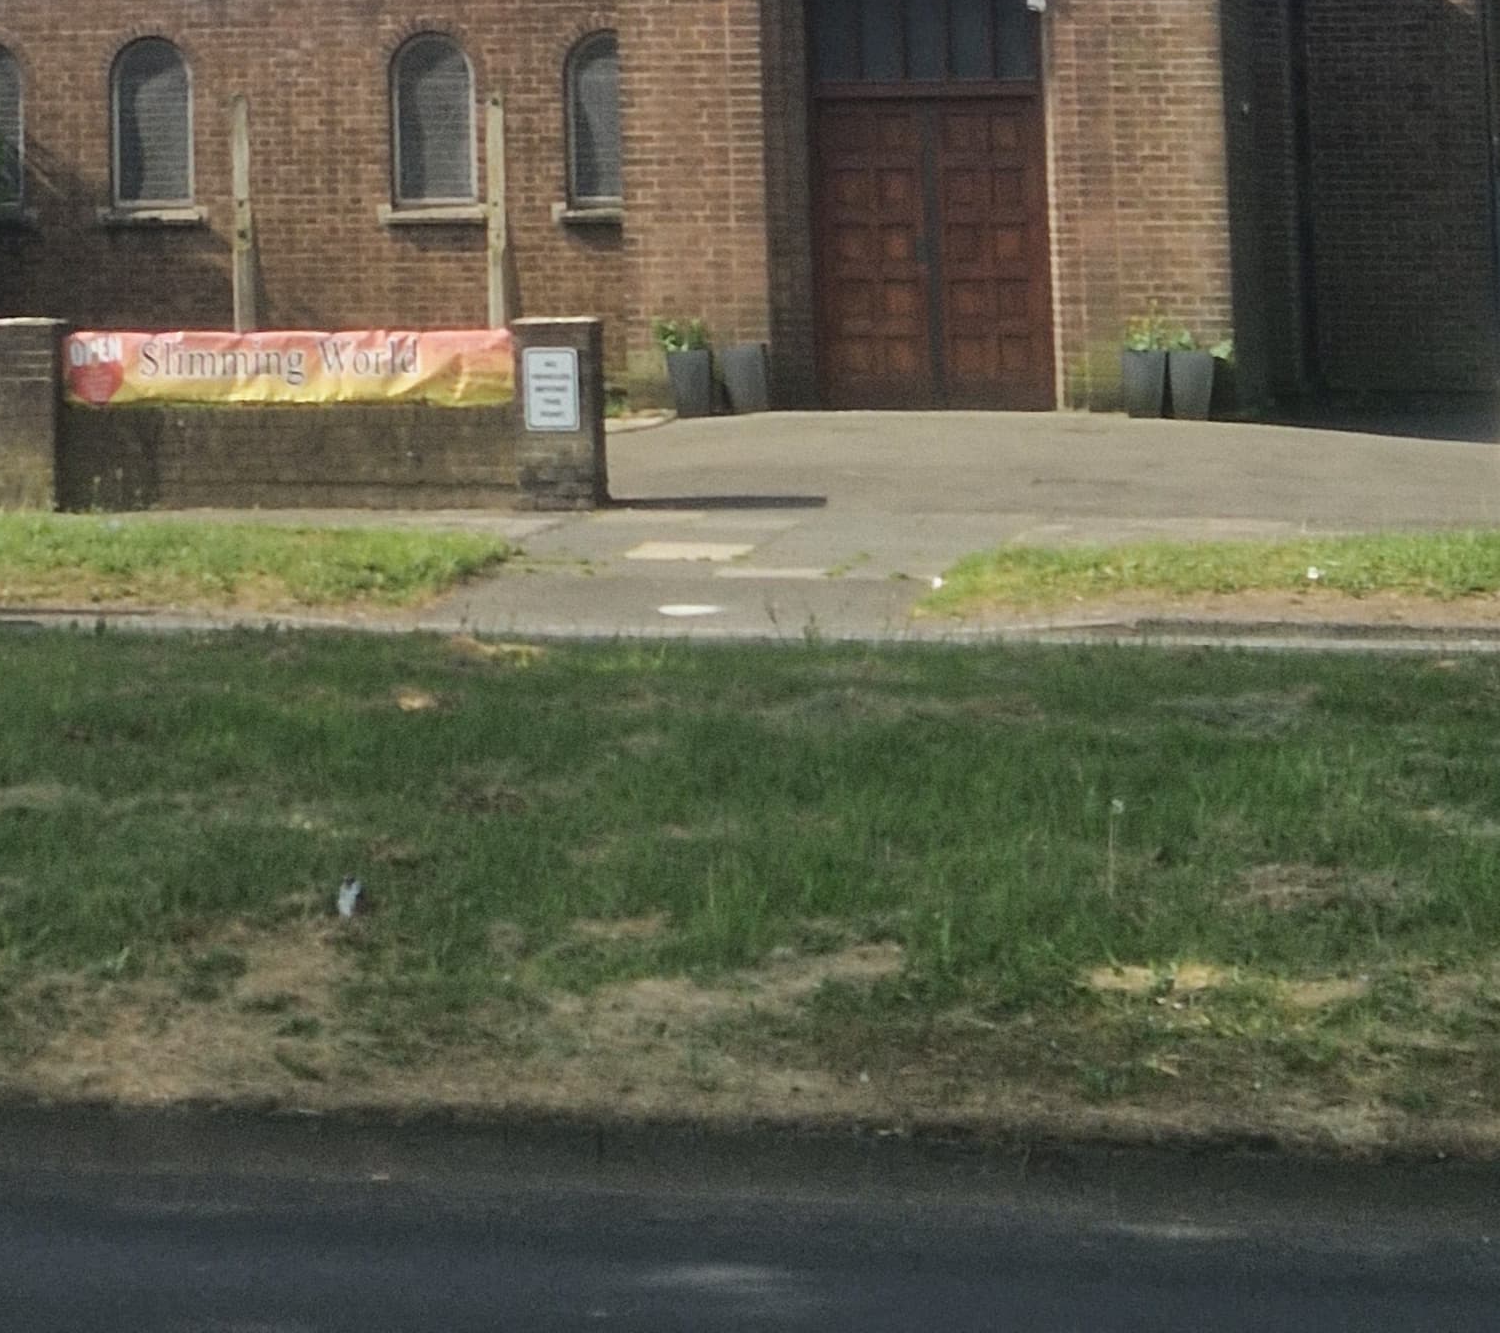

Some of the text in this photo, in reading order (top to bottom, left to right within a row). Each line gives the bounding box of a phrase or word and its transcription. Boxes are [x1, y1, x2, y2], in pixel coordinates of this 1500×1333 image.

[70, 336, 124, 367] OPEN
[140, 336, 420, 386] Slimming World
